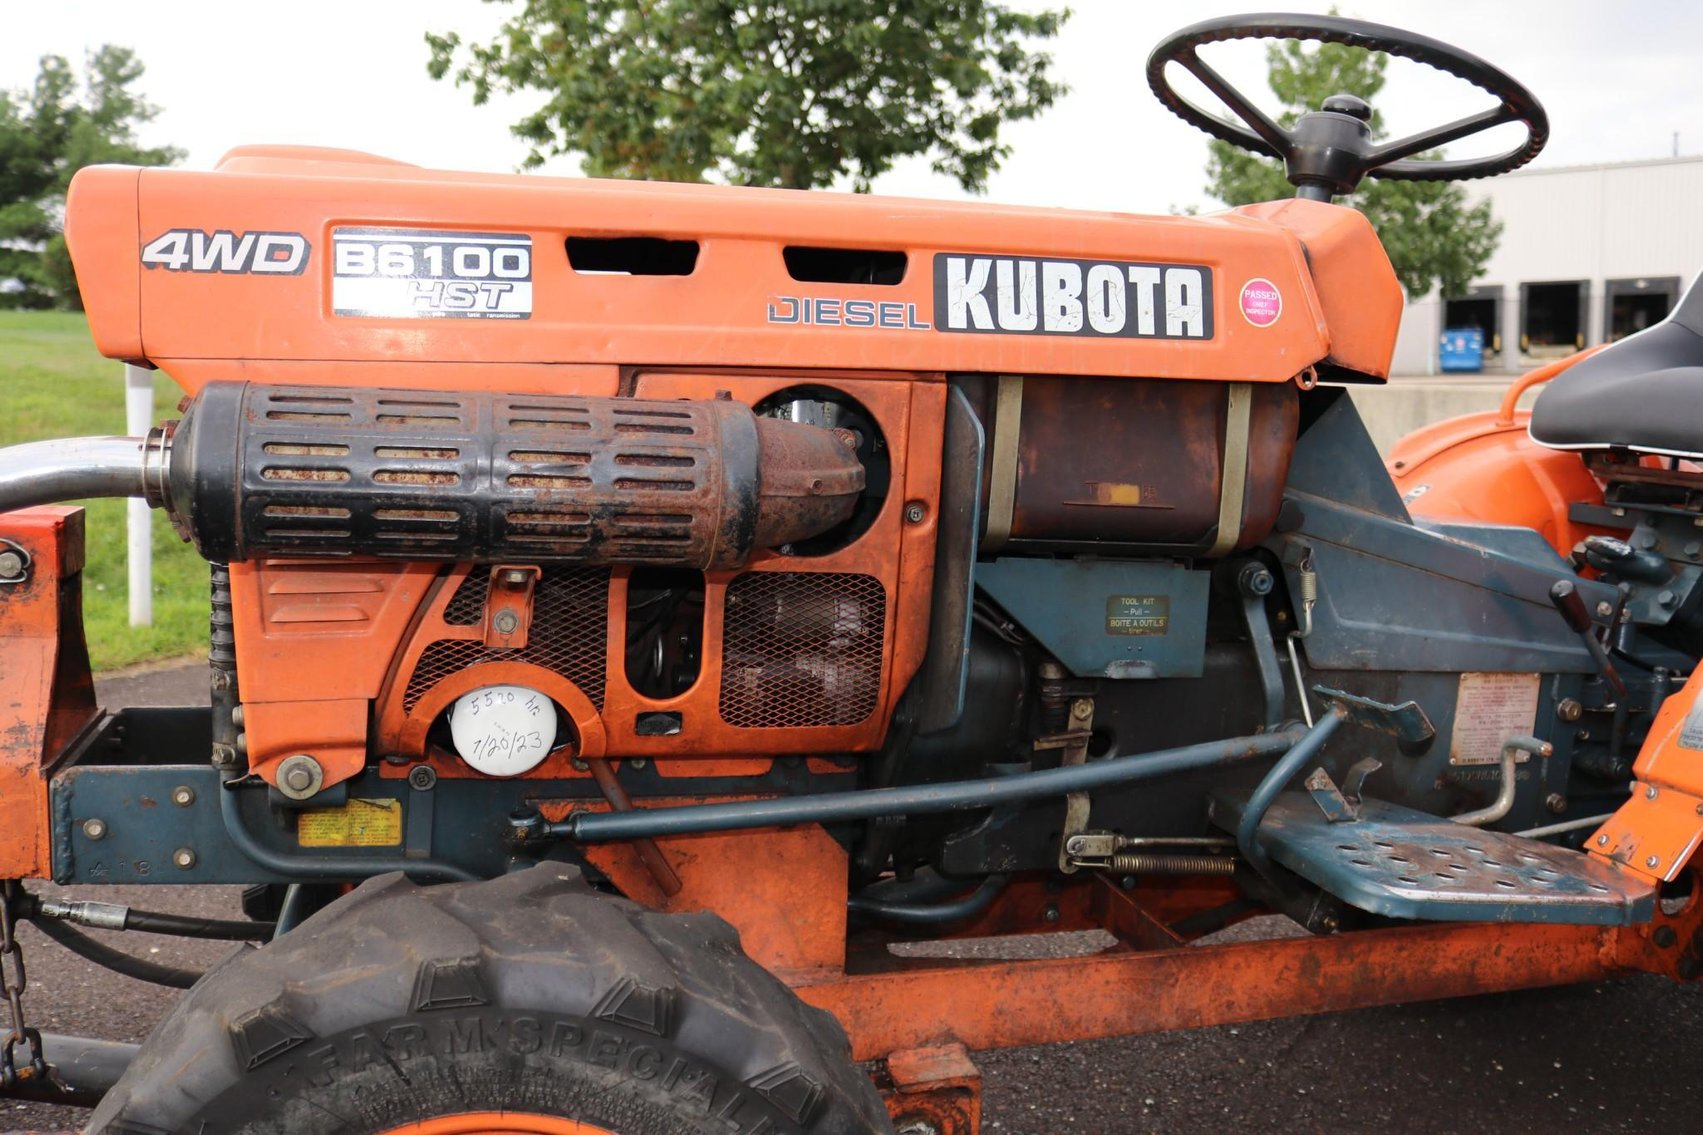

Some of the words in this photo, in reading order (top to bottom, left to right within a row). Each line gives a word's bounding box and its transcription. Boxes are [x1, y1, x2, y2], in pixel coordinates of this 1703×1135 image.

[142, 229, 311, 276] 4WD
[336, 243, 529, 278] B6100
[408, 281, 514, 310] HST
[946, 257, 1204, 336] KUBOTA
[1244, 289, 1278, 300] PASSED
[767, 297, 932, 331] DIESEL
[1121, 598, 1139, 606] TOOL
[1143, 598, 1155, 606] KIT
[471, 691, 515, 716] 5520
[473, 731, 542, 761] 7/20/23
[304, 1015, 482, 1087] FARM
[508, 1016, 743, 1133] SPECIAL
